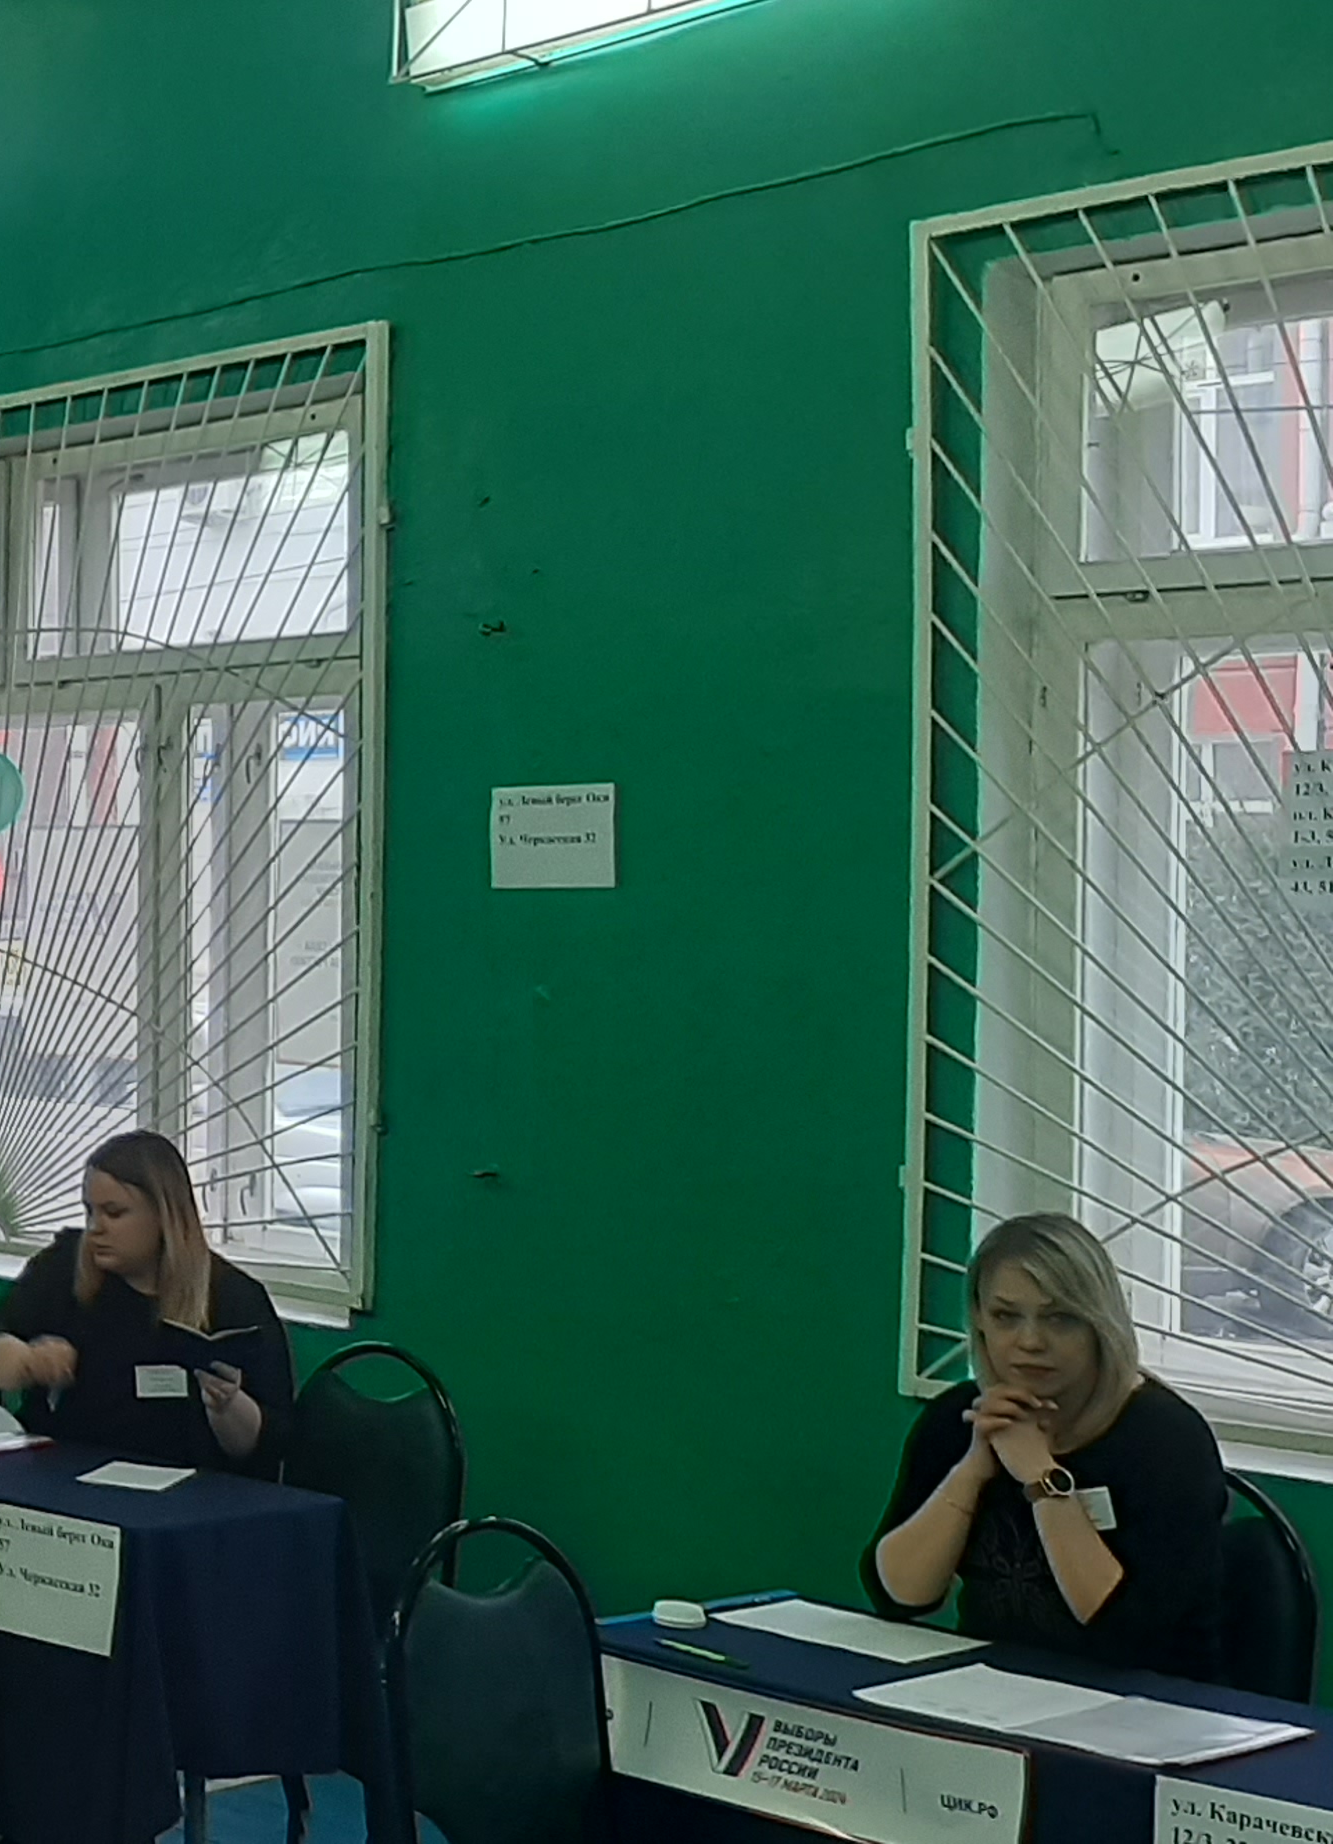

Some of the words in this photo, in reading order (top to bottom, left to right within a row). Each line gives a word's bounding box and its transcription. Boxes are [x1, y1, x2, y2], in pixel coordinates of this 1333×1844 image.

[773, 1719, 838, 1747] ВЫБОРЫ
[757, 1754, 820, 1781] РОССИИ
[766, 1736, 860, 1772] ПРЕЗИДЕНТА
[1171, 1799, 1202, 1817] ул.
